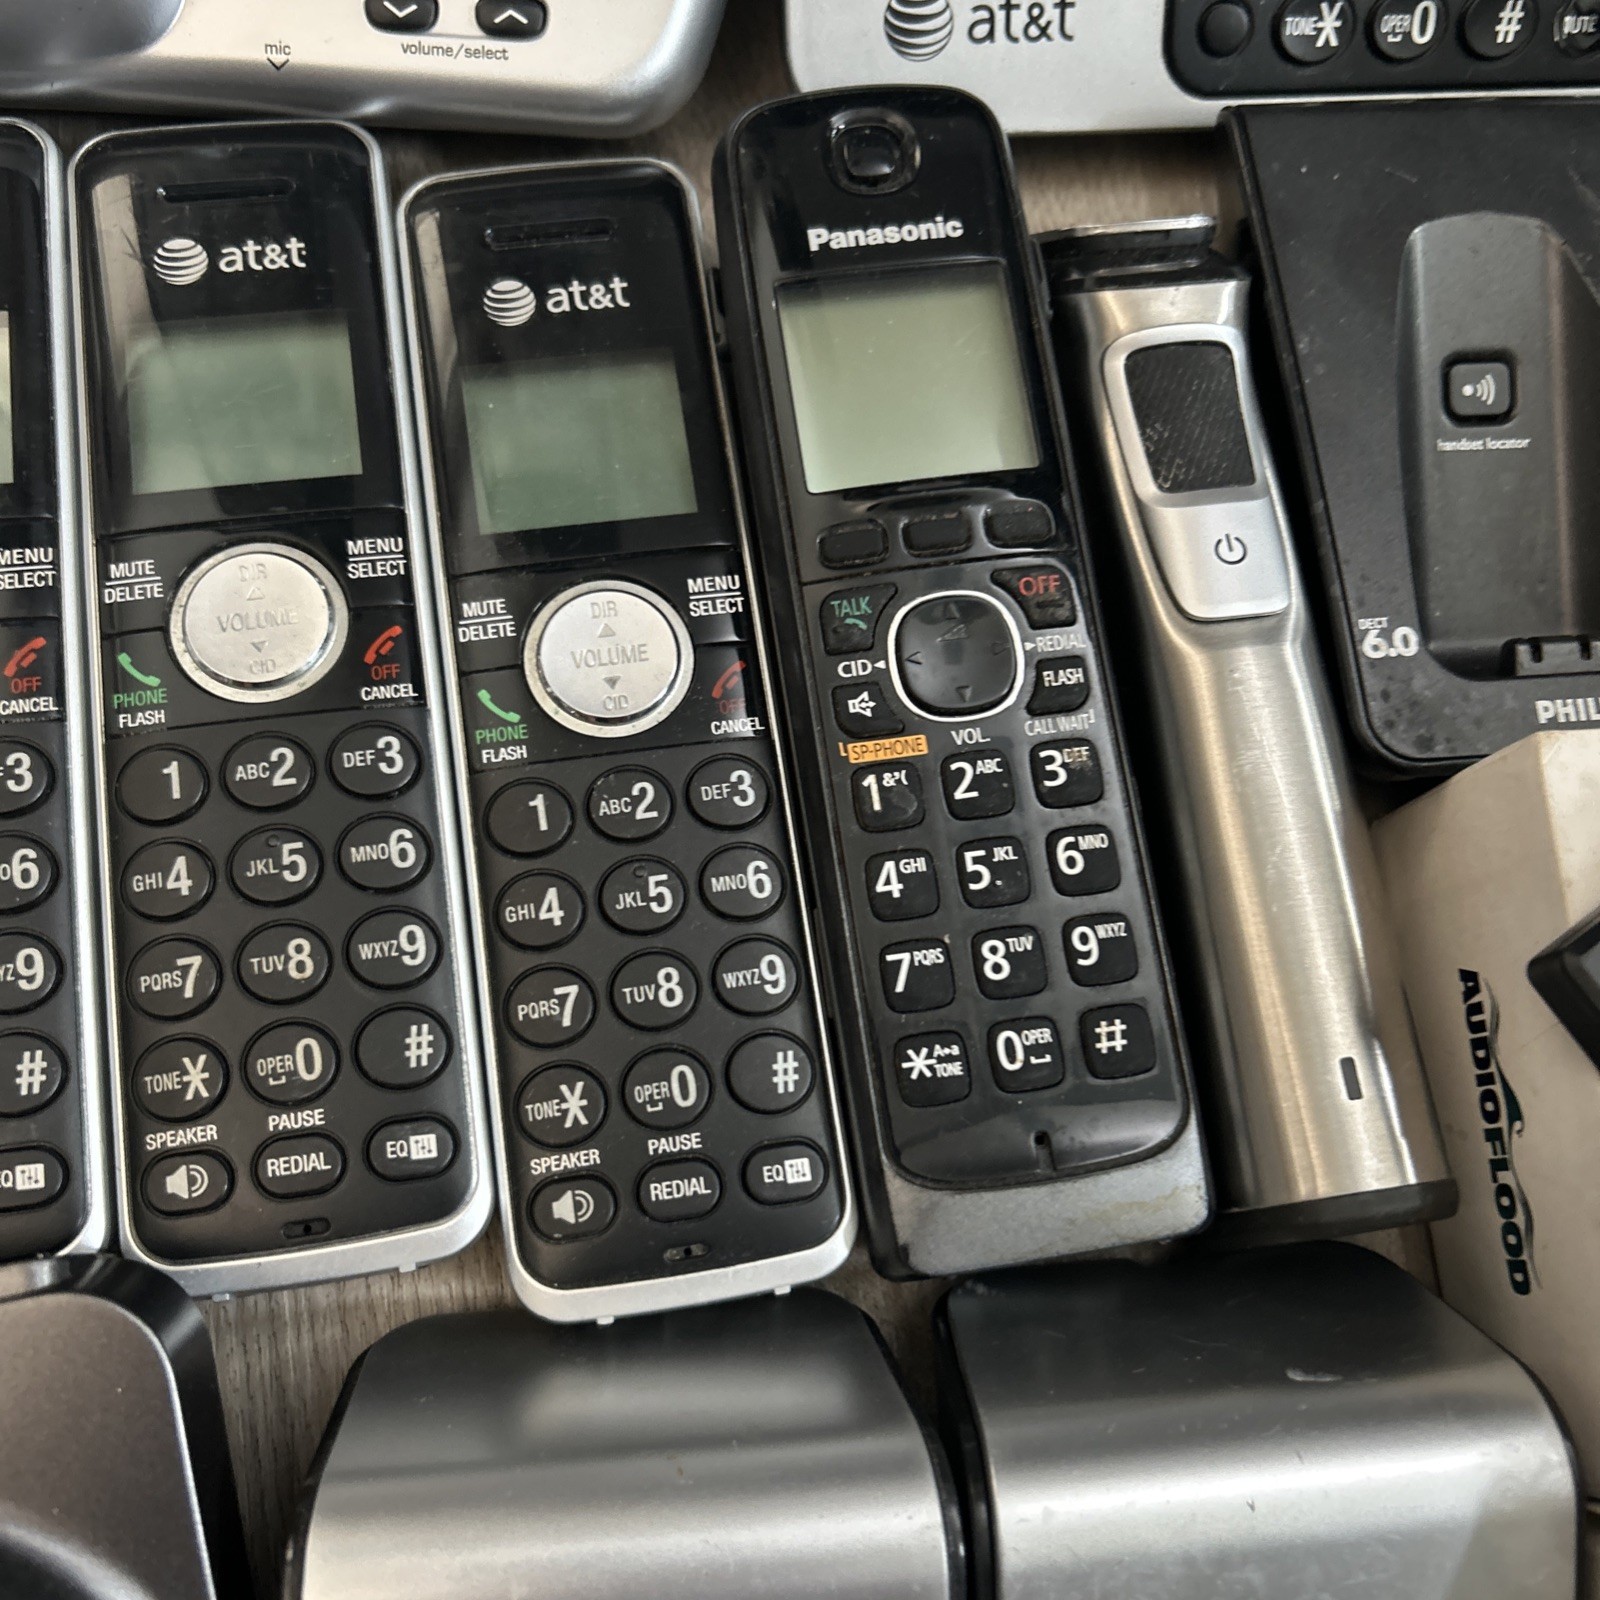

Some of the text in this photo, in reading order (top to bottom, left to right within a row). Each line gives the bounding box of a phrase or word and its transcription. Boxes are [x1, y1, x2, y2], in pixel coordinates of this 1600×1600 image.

[967, 0, 1076, 44] at&t
[264, 40, 292, 55] mic
[401, 41, 509, 61] volume/select
[807, 216, 964, 252] Panasonic
[218, 236, 307, 273] at&t
[546, 276, 631, 313] at&t
[346, 537, 404, 556] MENU
[110, 559, 156, 579] MUTE
[346, 559, 407, 579] SELECT
[103, 583, 164, 604] DELETE
[687, 574, 741, 593] MENU
[1017, 573, 1062, 596] OFF
[462, 599, 507, 618] MUTE
[590, 600, 618, 619] DIR
[689, 597, 745, 617] SELECT
[830, 595, 873, 618] TALK
[458, 622, 517, 643] DELETE
[1036, 634, 1087, 652] REDIAL
[1361, 626, 1420, 659] 6.0
[570, 643, 650, 669] VOLUME
[370, 663, 401, 681] OFF
[837, 659, 873, 678] CID
[1042, 667, 1084, 687] FLASH
[11, 677, 42, 694] OFF
[360, 682, 419, 701] CANCEL
[0, 696, 59, 716] CANCEL
[113, 687, 168, 709] PHONE
[602, 694, 629, 712] CID
[118, 710, 166, 728] FLASH
[1535, 697, 1600, 724] PHIL
[475, 724, 529, 745] PHONE
[710, 716, 766, 735] CANCEL
[1024, 717, 1057, 736] CALL
[481, 745, 528, 764] FLASH
[851, 737, 924, 761] SP-PHONE
[950, 758, 1003, 800] 2 ABC
[1038, 749, 1068, 787] 3
[161, 760, 181, 801] 1
[527, 793, 549, 832] 1
[1056, 832, 1109, 876] 6 MNO
[875, 857, 927, 899] 4 GHI
[963, 845, 1018, 891] 5 JKL
[1070, 922, 1128, 966] 9 WXYZ
[980, 935, 1034, 981] 8 TUV
[885, 947, 945, 993] 7 PQRS
[404, 1023, 435, 1068] #
[1021, 1027, 1053, 1045] OPER
[1094, 1018, 1128, 1055] #
[15, 1050, 47, 1095] #
[771, 1050, 800, 1094] #
[935, 1061, 965, 1078] TONE
[268, 1110, 326, 1131] PAUSE
[145, 1125, 218, 1151] SPEAKER
[1458, 968, 1531, 1296] AUDIOFLOOD
[386, 1141, 408, 1160] EQ
[647, 1132, 703, 1155] PAUSE
[266, 1152, 332, 1177] REDIAL
[530, 1148, 601, 1175] SPEAKER
[763, 1165, 784, 1183] EQ
[649, 1177, 712, 1201] REDIAL
